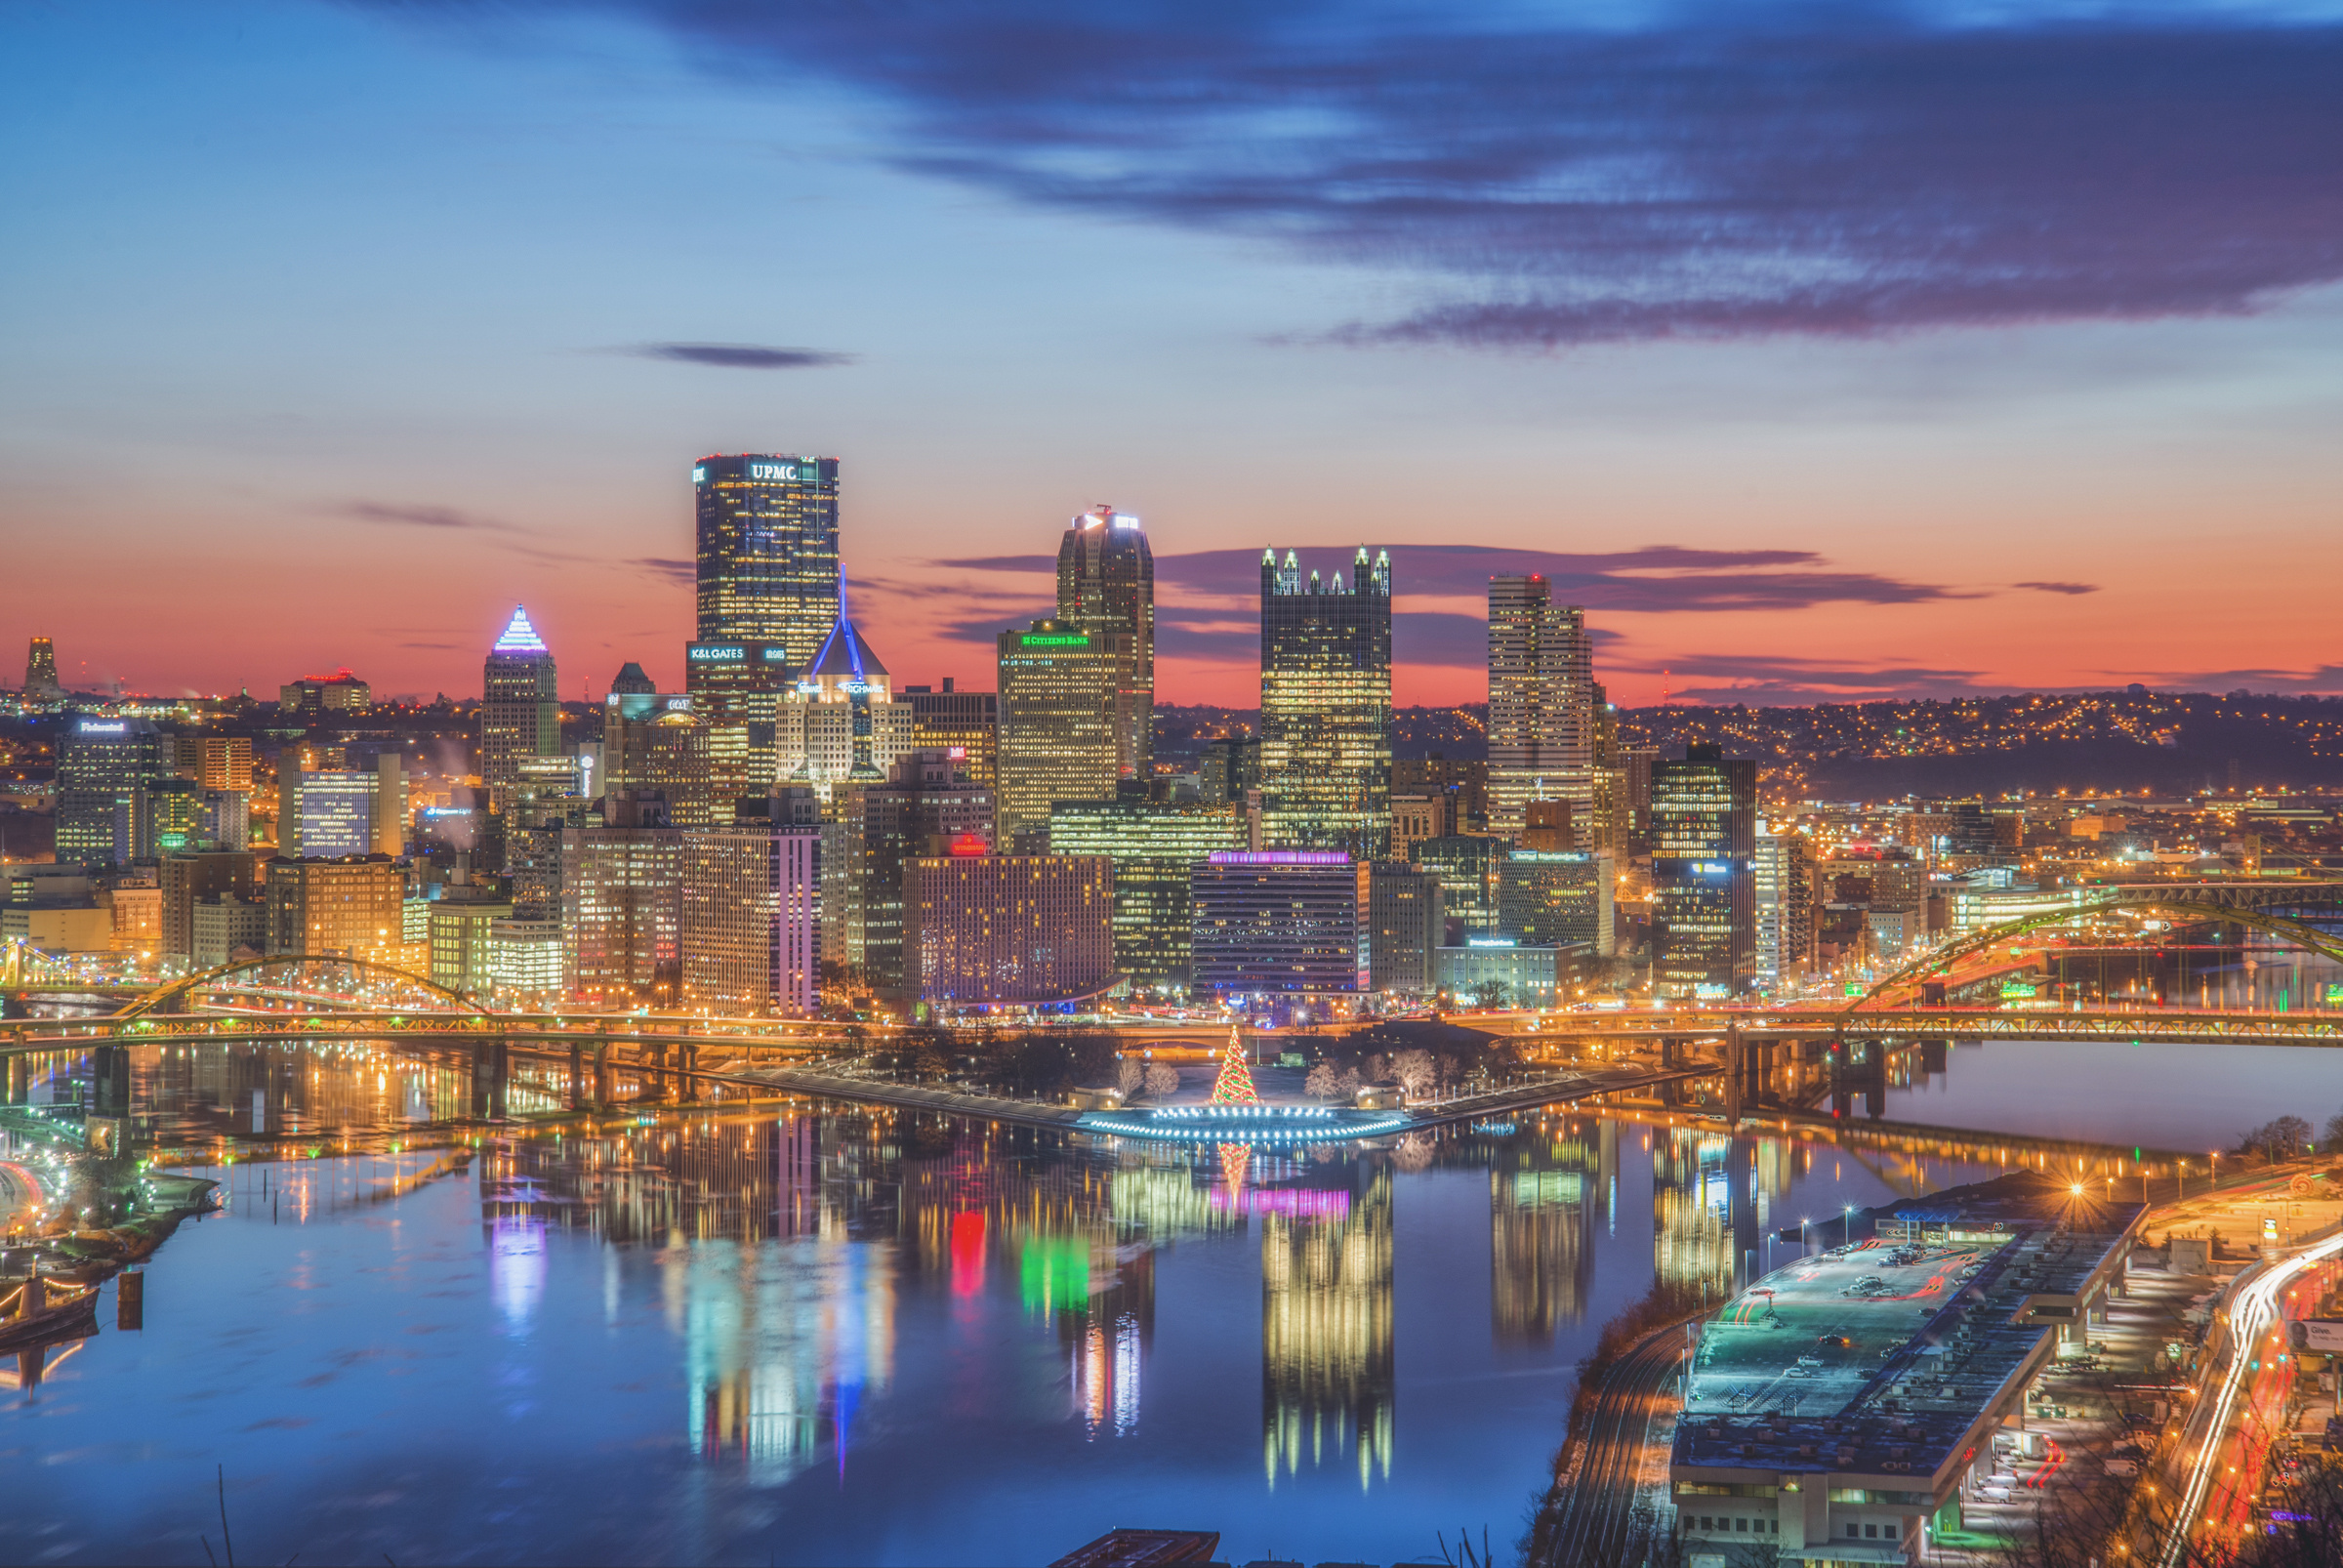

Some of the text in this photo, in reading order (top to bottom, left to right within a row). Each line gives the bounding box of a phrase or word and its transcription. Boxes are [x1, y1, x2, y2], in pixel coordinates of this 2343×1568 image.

[752, 465, 797, 479] UPMC
[691, 648, 744, 659] K&L GATES
[1936, 873, 1952, 882] PNC
